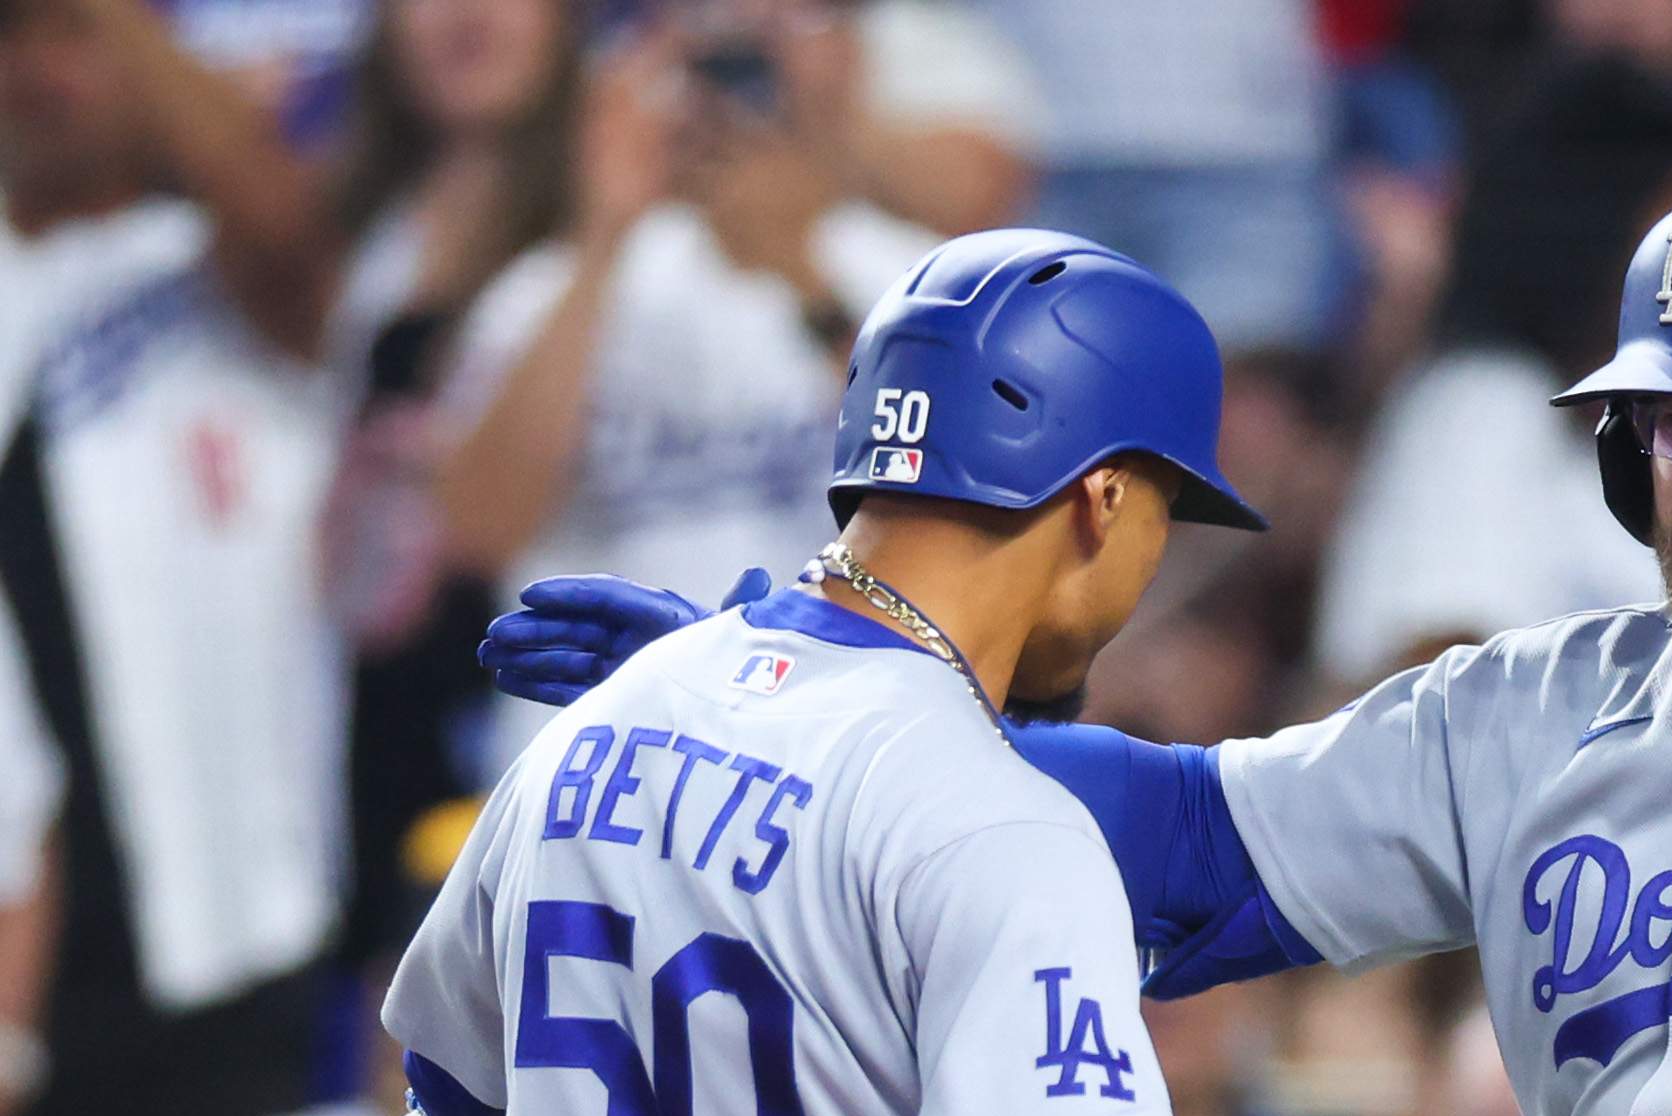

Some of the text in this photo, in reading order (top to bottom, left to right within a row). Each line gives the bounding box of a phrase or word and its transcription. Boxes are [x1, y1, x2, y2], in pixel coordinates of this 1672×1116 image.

[871, 387, 931, 443] 50
[543, 725, 812, 895] BETTS
[1034, 966, 1135, 1103] LA
